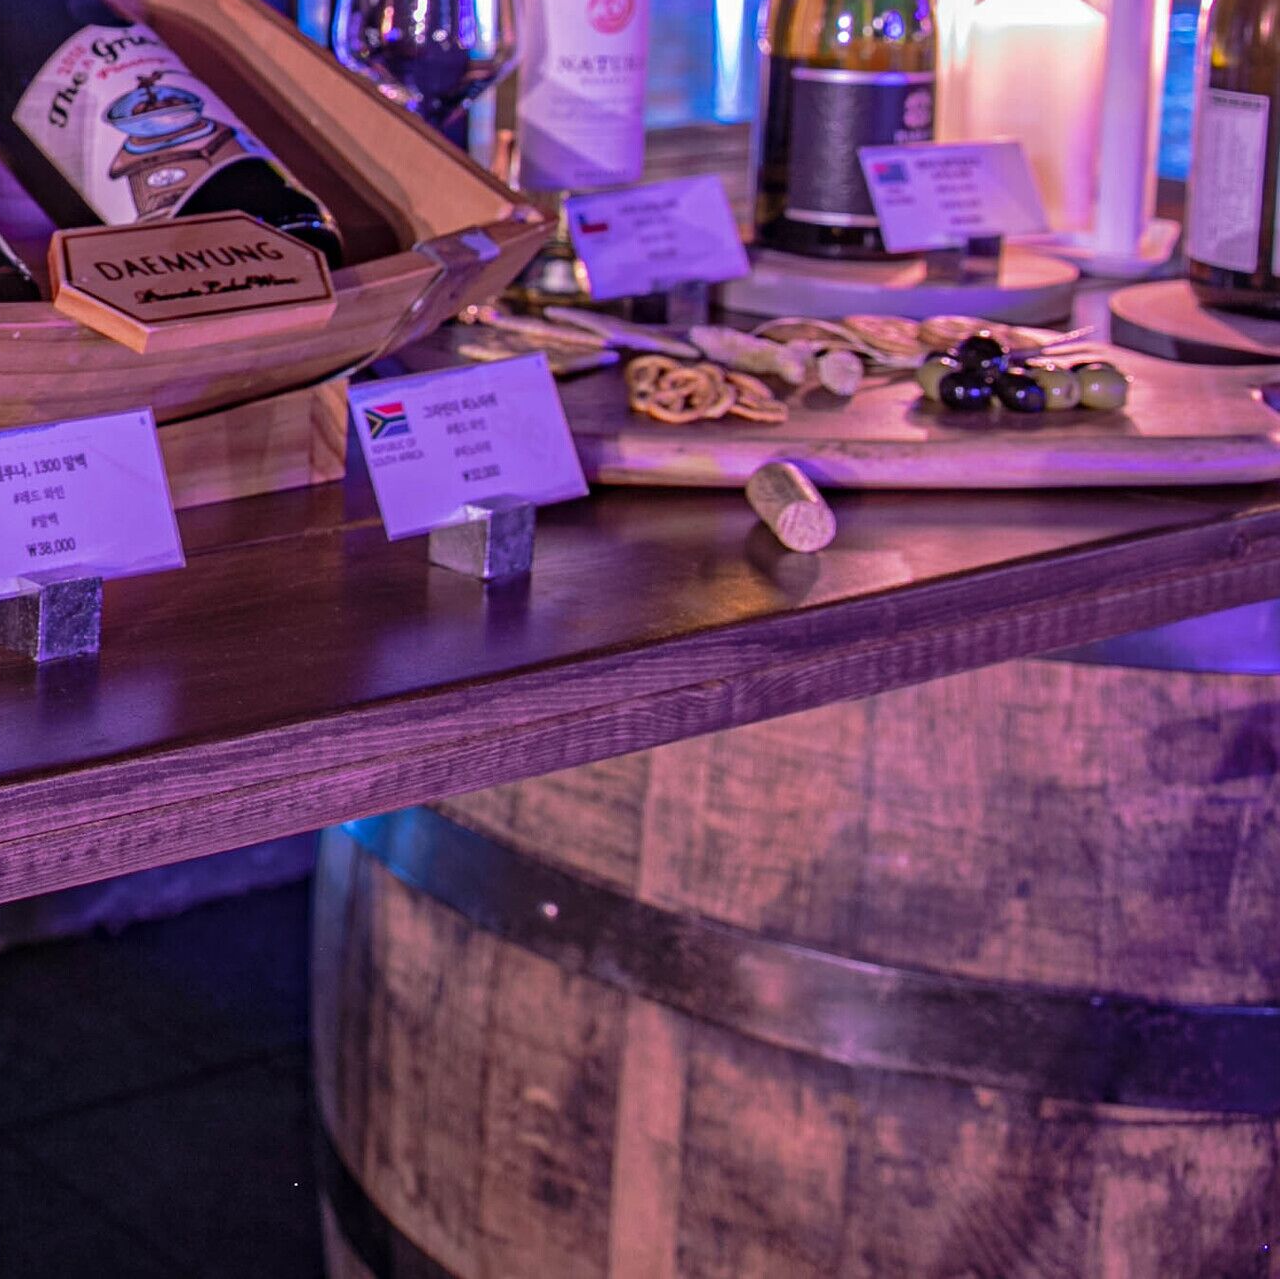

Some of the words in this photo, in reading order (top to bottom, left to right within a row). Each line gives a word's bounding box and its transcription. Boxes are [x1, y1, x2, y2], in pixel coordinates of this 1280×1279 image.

[49, 72, 88, 128] The
[93, 240, 284, 281] DAEMYUNG
[34, 457, 62, 475] 1300
